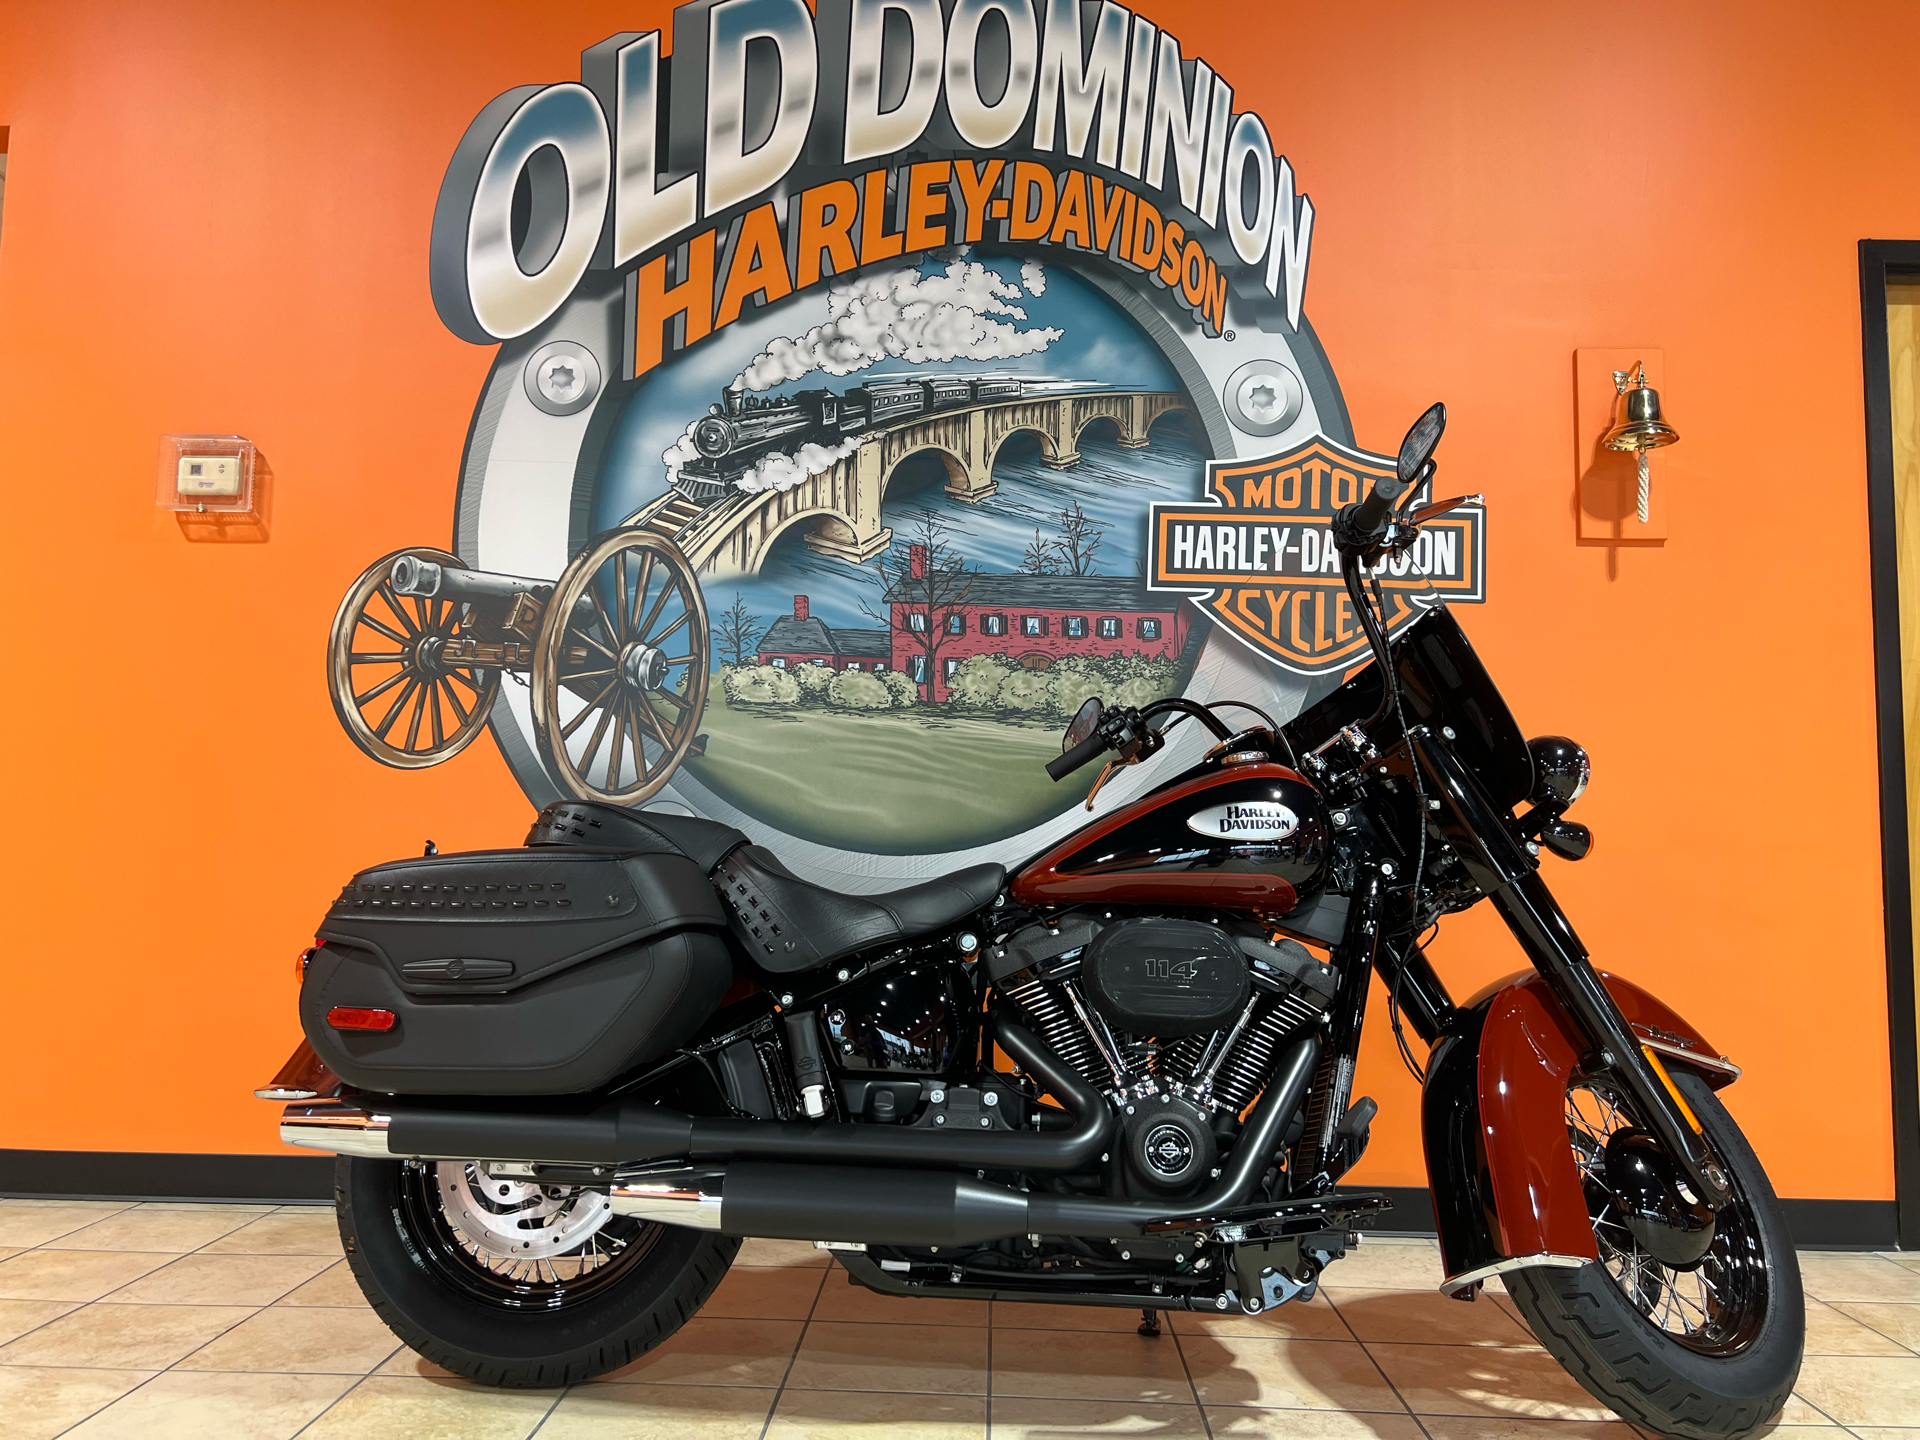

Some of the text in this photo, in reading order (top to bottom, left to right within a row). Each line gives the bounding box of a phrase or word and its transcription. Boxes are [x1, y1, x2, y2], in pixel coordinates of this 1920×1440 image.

[466, 0, 1316, 343] OLD DOMINION
[1174, 524, 1456, 576] HARLEY-DAON
[1237, 589, 1384, 653] CYCLE
[1219, 818, 1290, 833] DAVIDSON
[1145, 959, 1198, 980] 114
